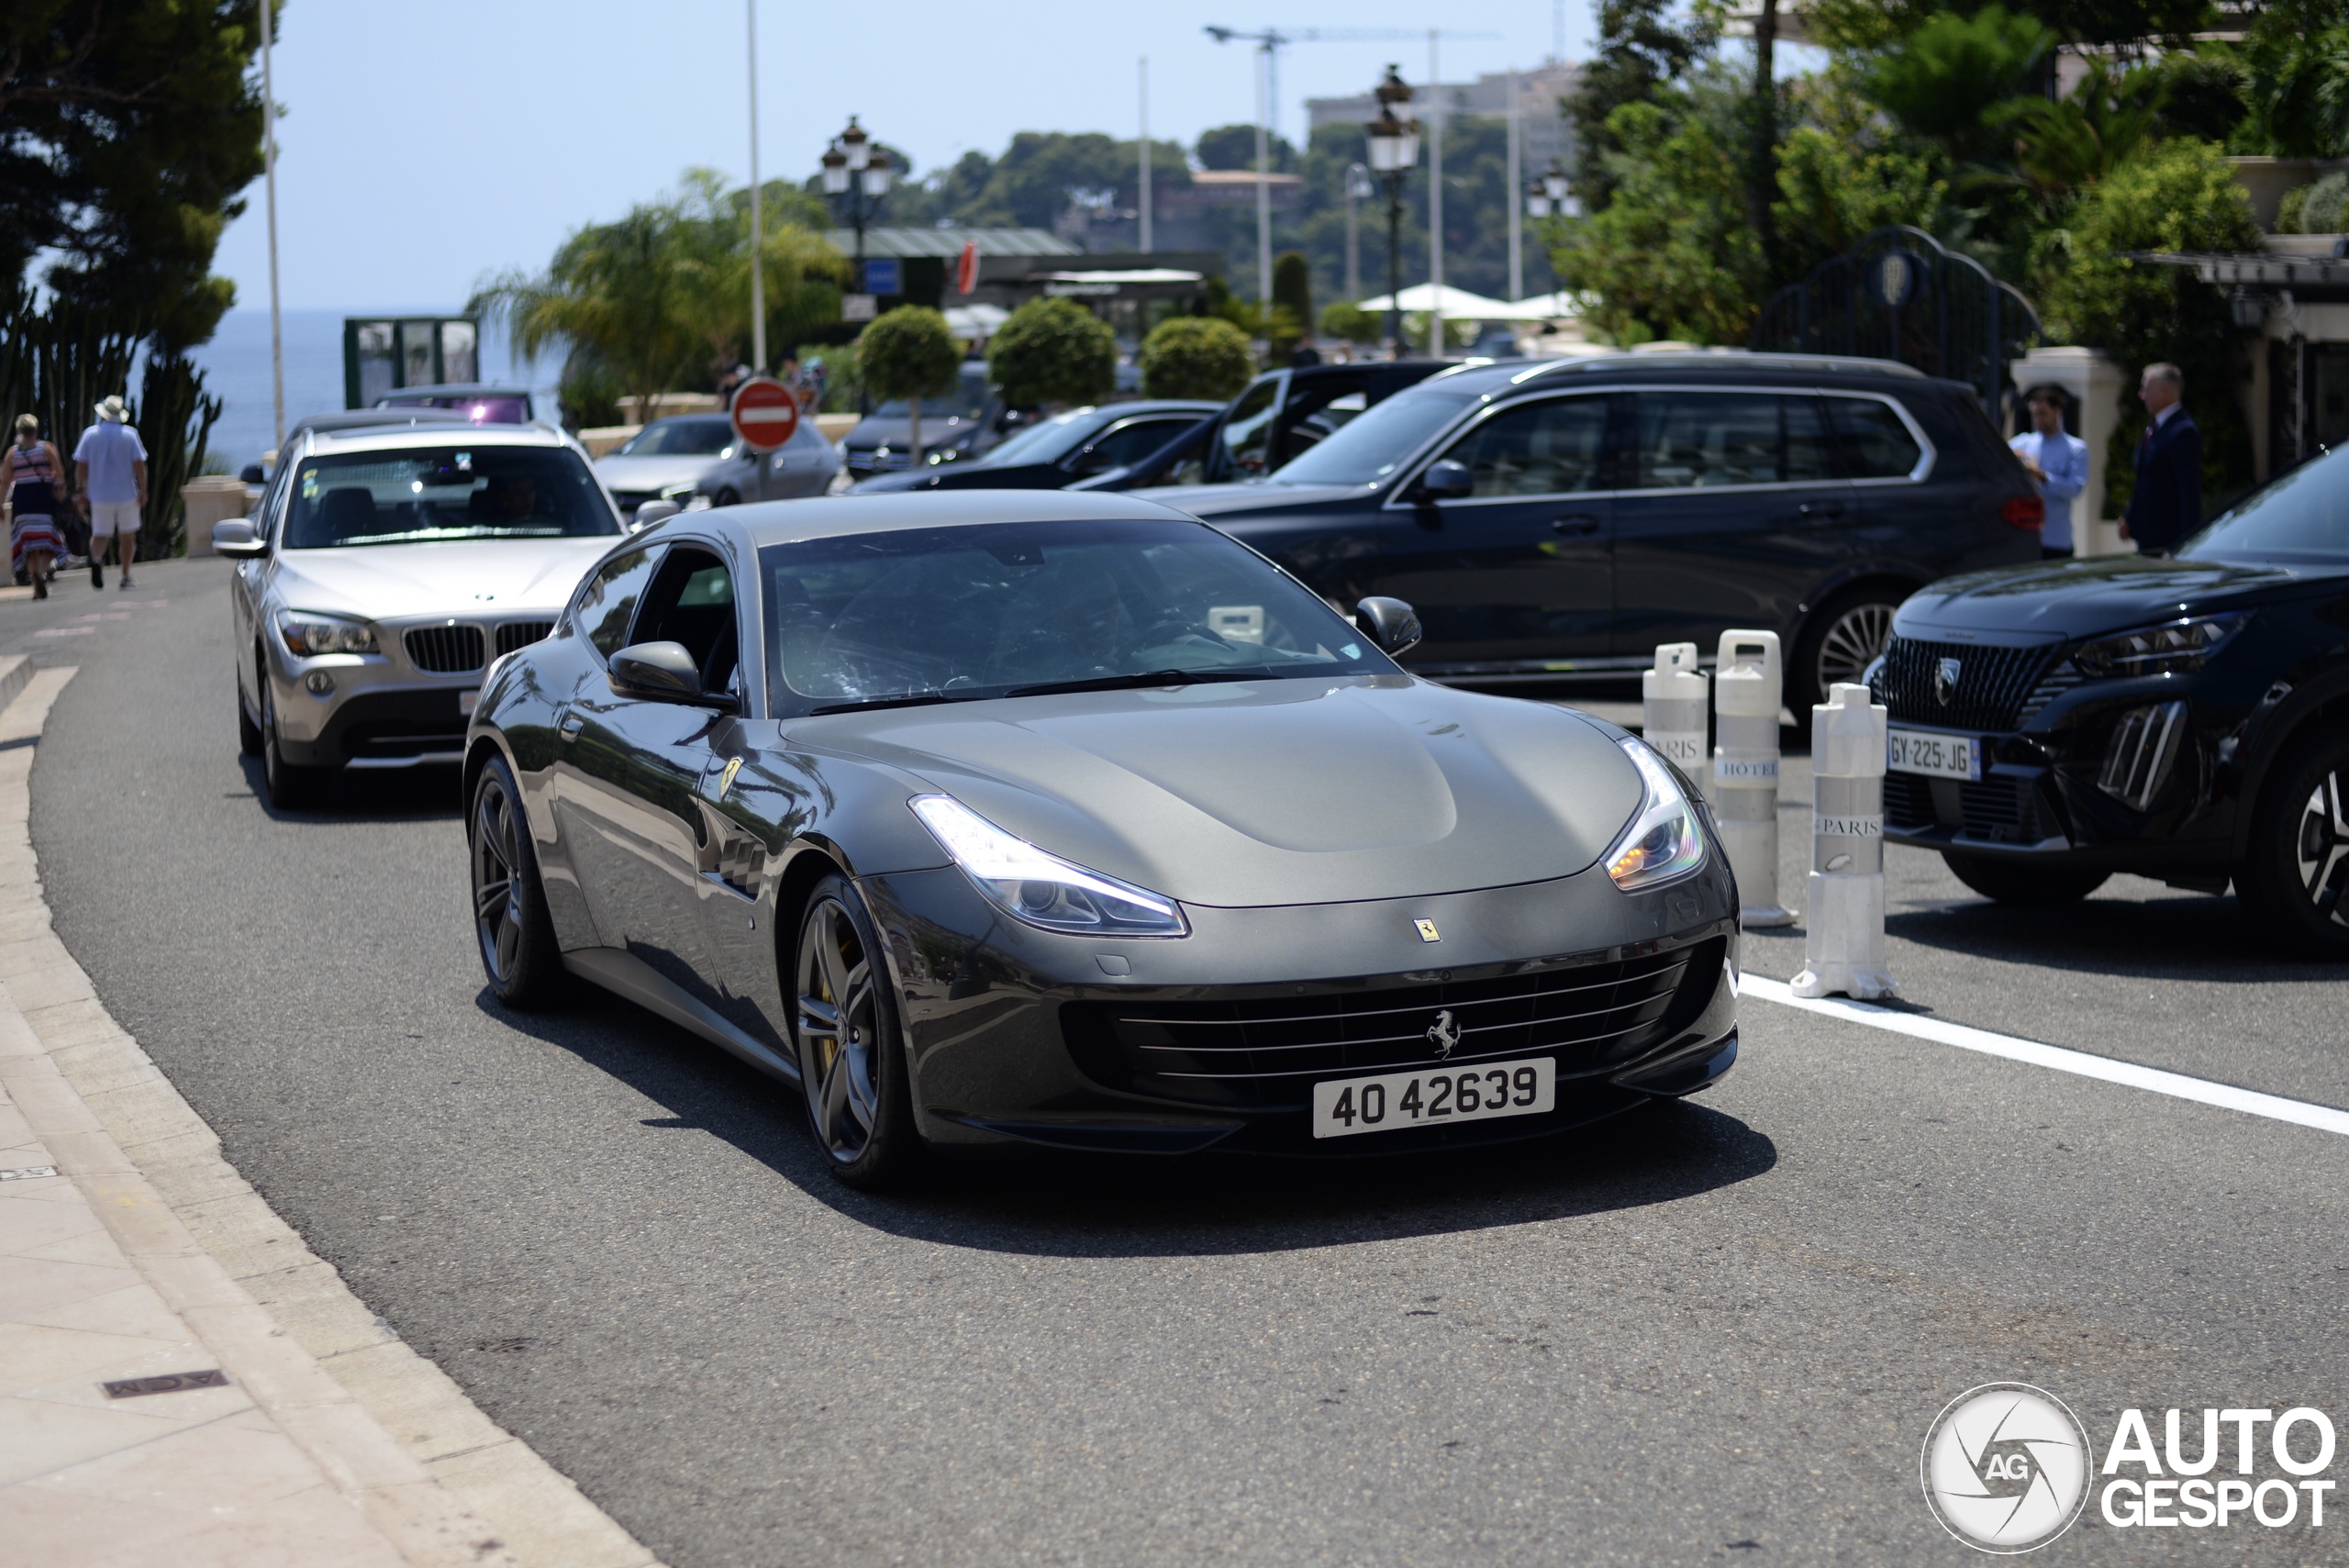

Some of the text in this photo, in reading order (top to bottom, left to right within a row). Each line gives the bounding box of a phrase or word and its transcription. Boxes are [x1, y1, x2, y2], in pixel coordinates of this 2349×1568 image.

[1649, 739, 1697, 760] ARIS
[1824, 818, 1878, 837] PARIS
[1332, 1066, 1538, 1128] 40 42639
